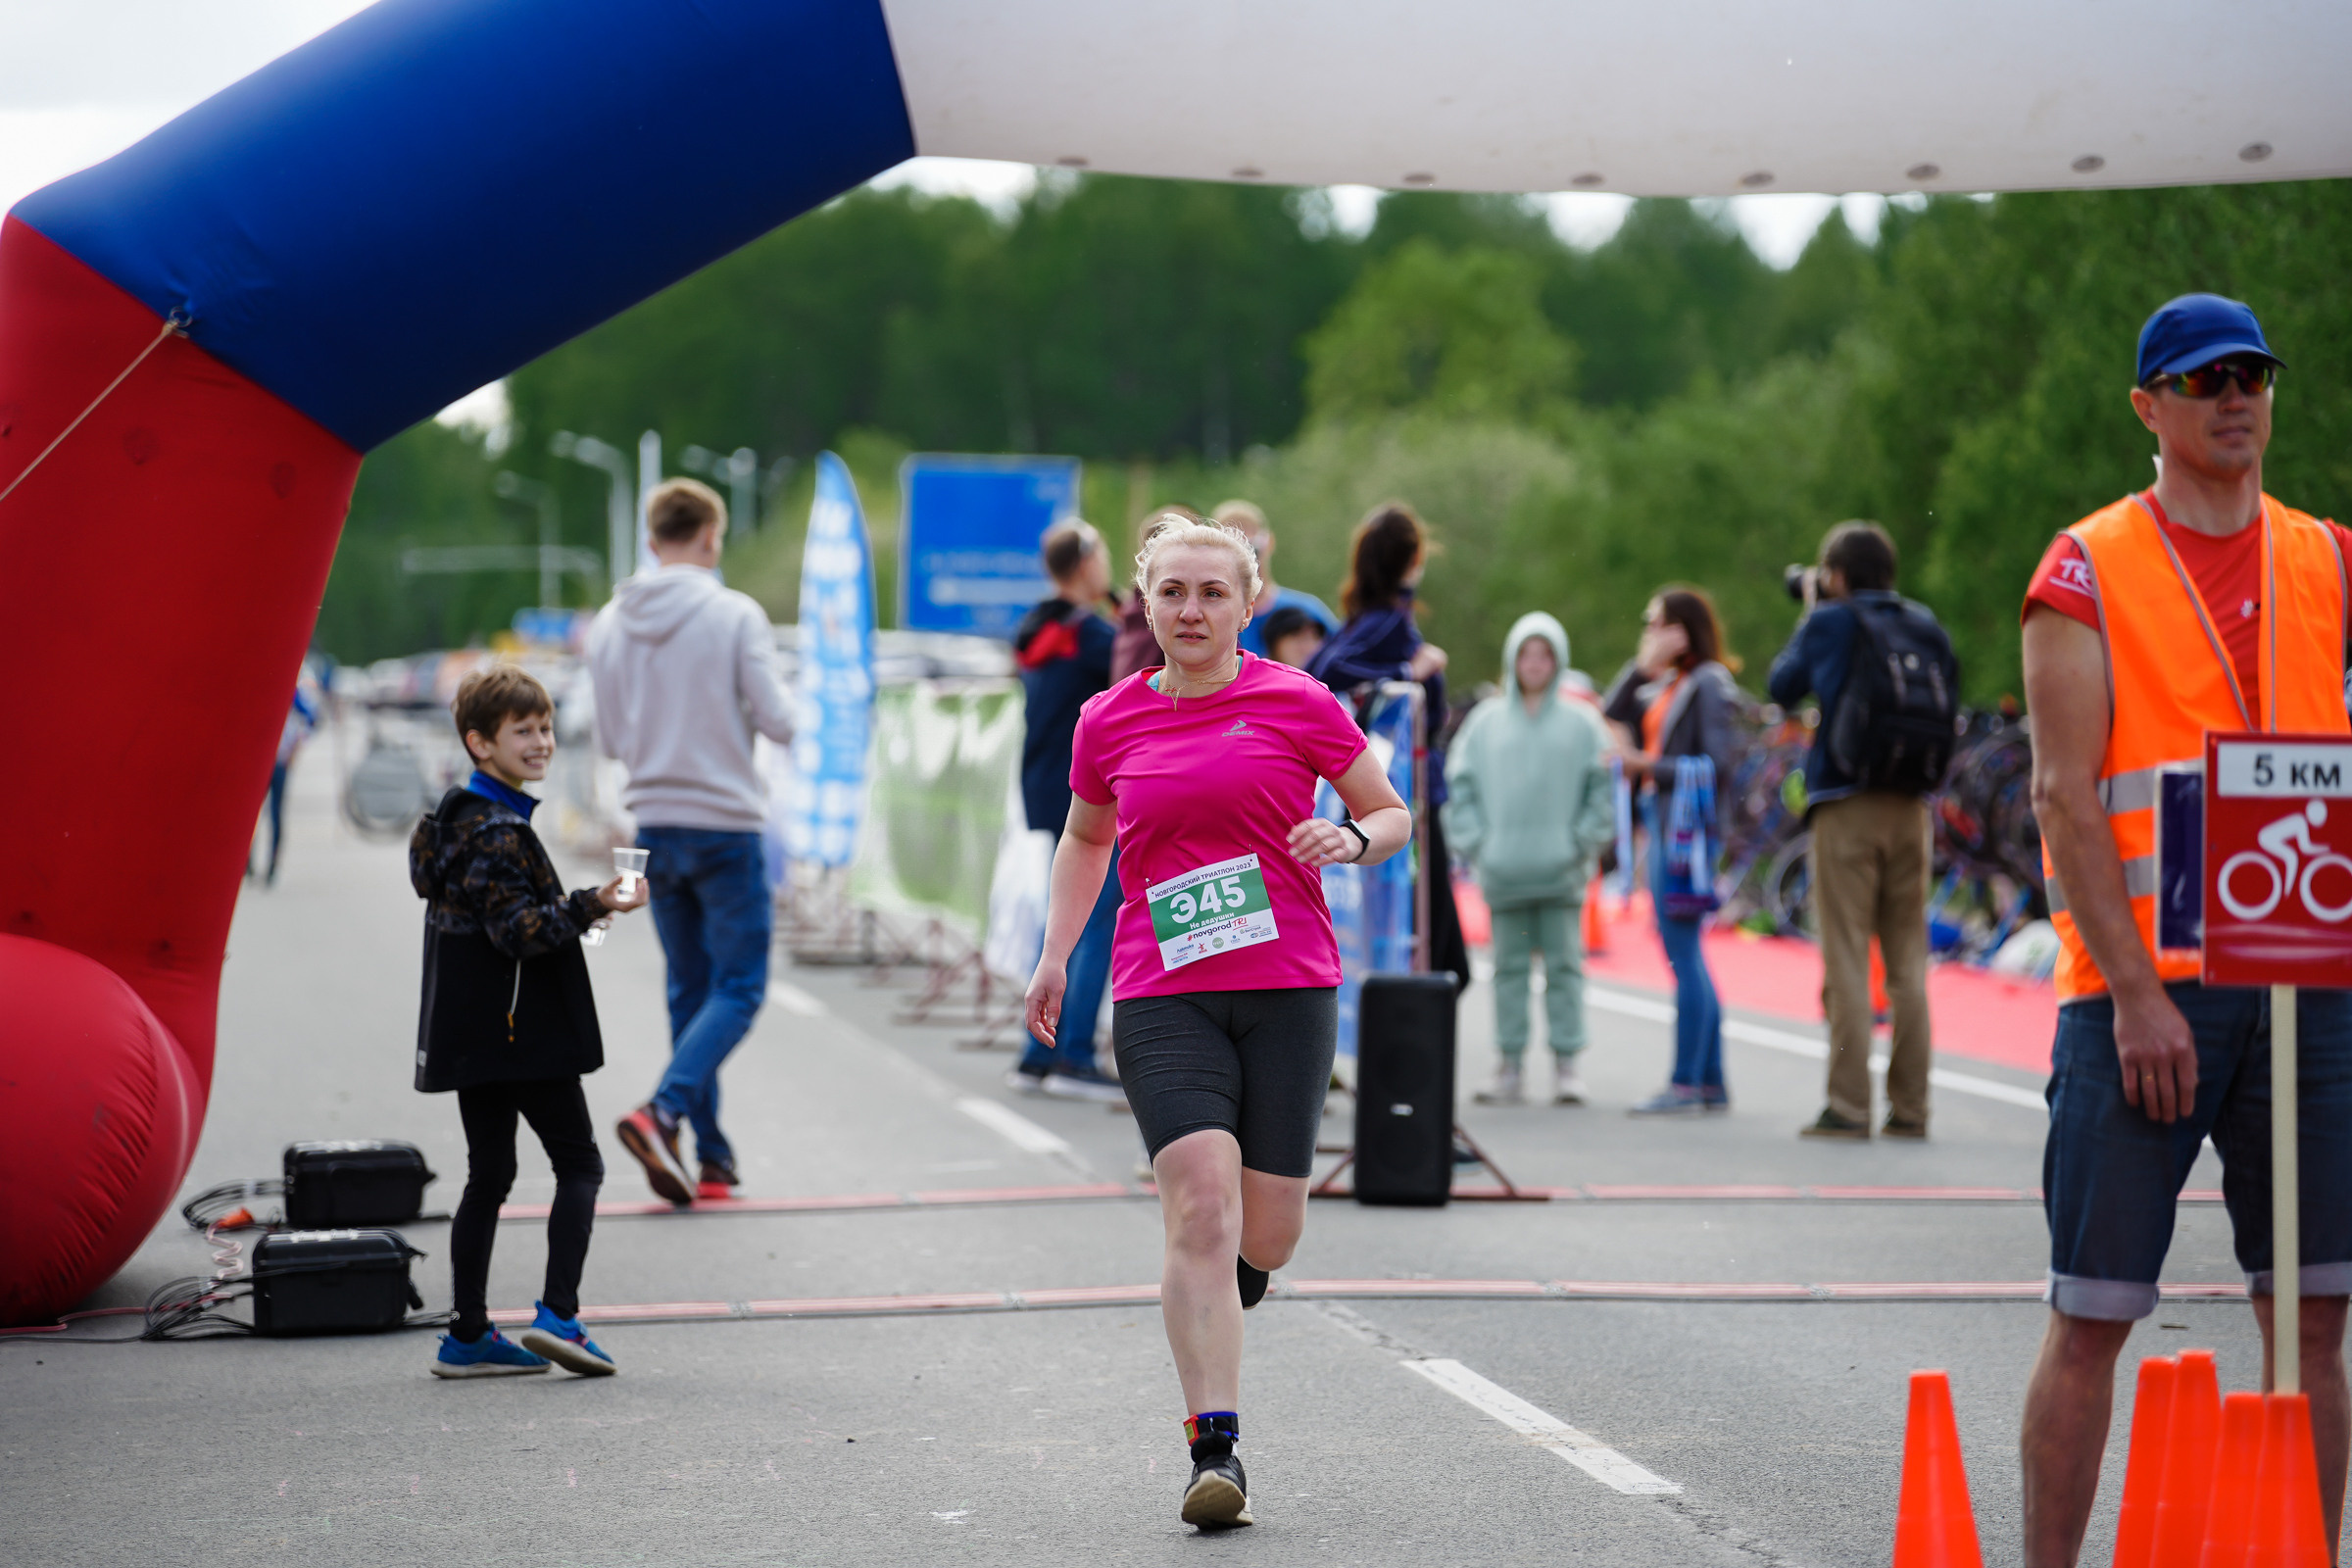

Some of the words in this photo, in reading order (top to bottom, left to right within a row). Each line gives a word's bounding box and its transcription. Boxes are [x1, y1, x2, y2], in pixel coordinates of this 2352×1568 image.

[2253, 753, 2275, 788] 5
[1154, 875, 1200, 898] НОВГОРОДСКИЙ
[1201, 866, 1235, 881] ТРИАТЛОН
[1236, 862, 1251, 871] 2023
[1169, 875, 1247, 924] Э45
